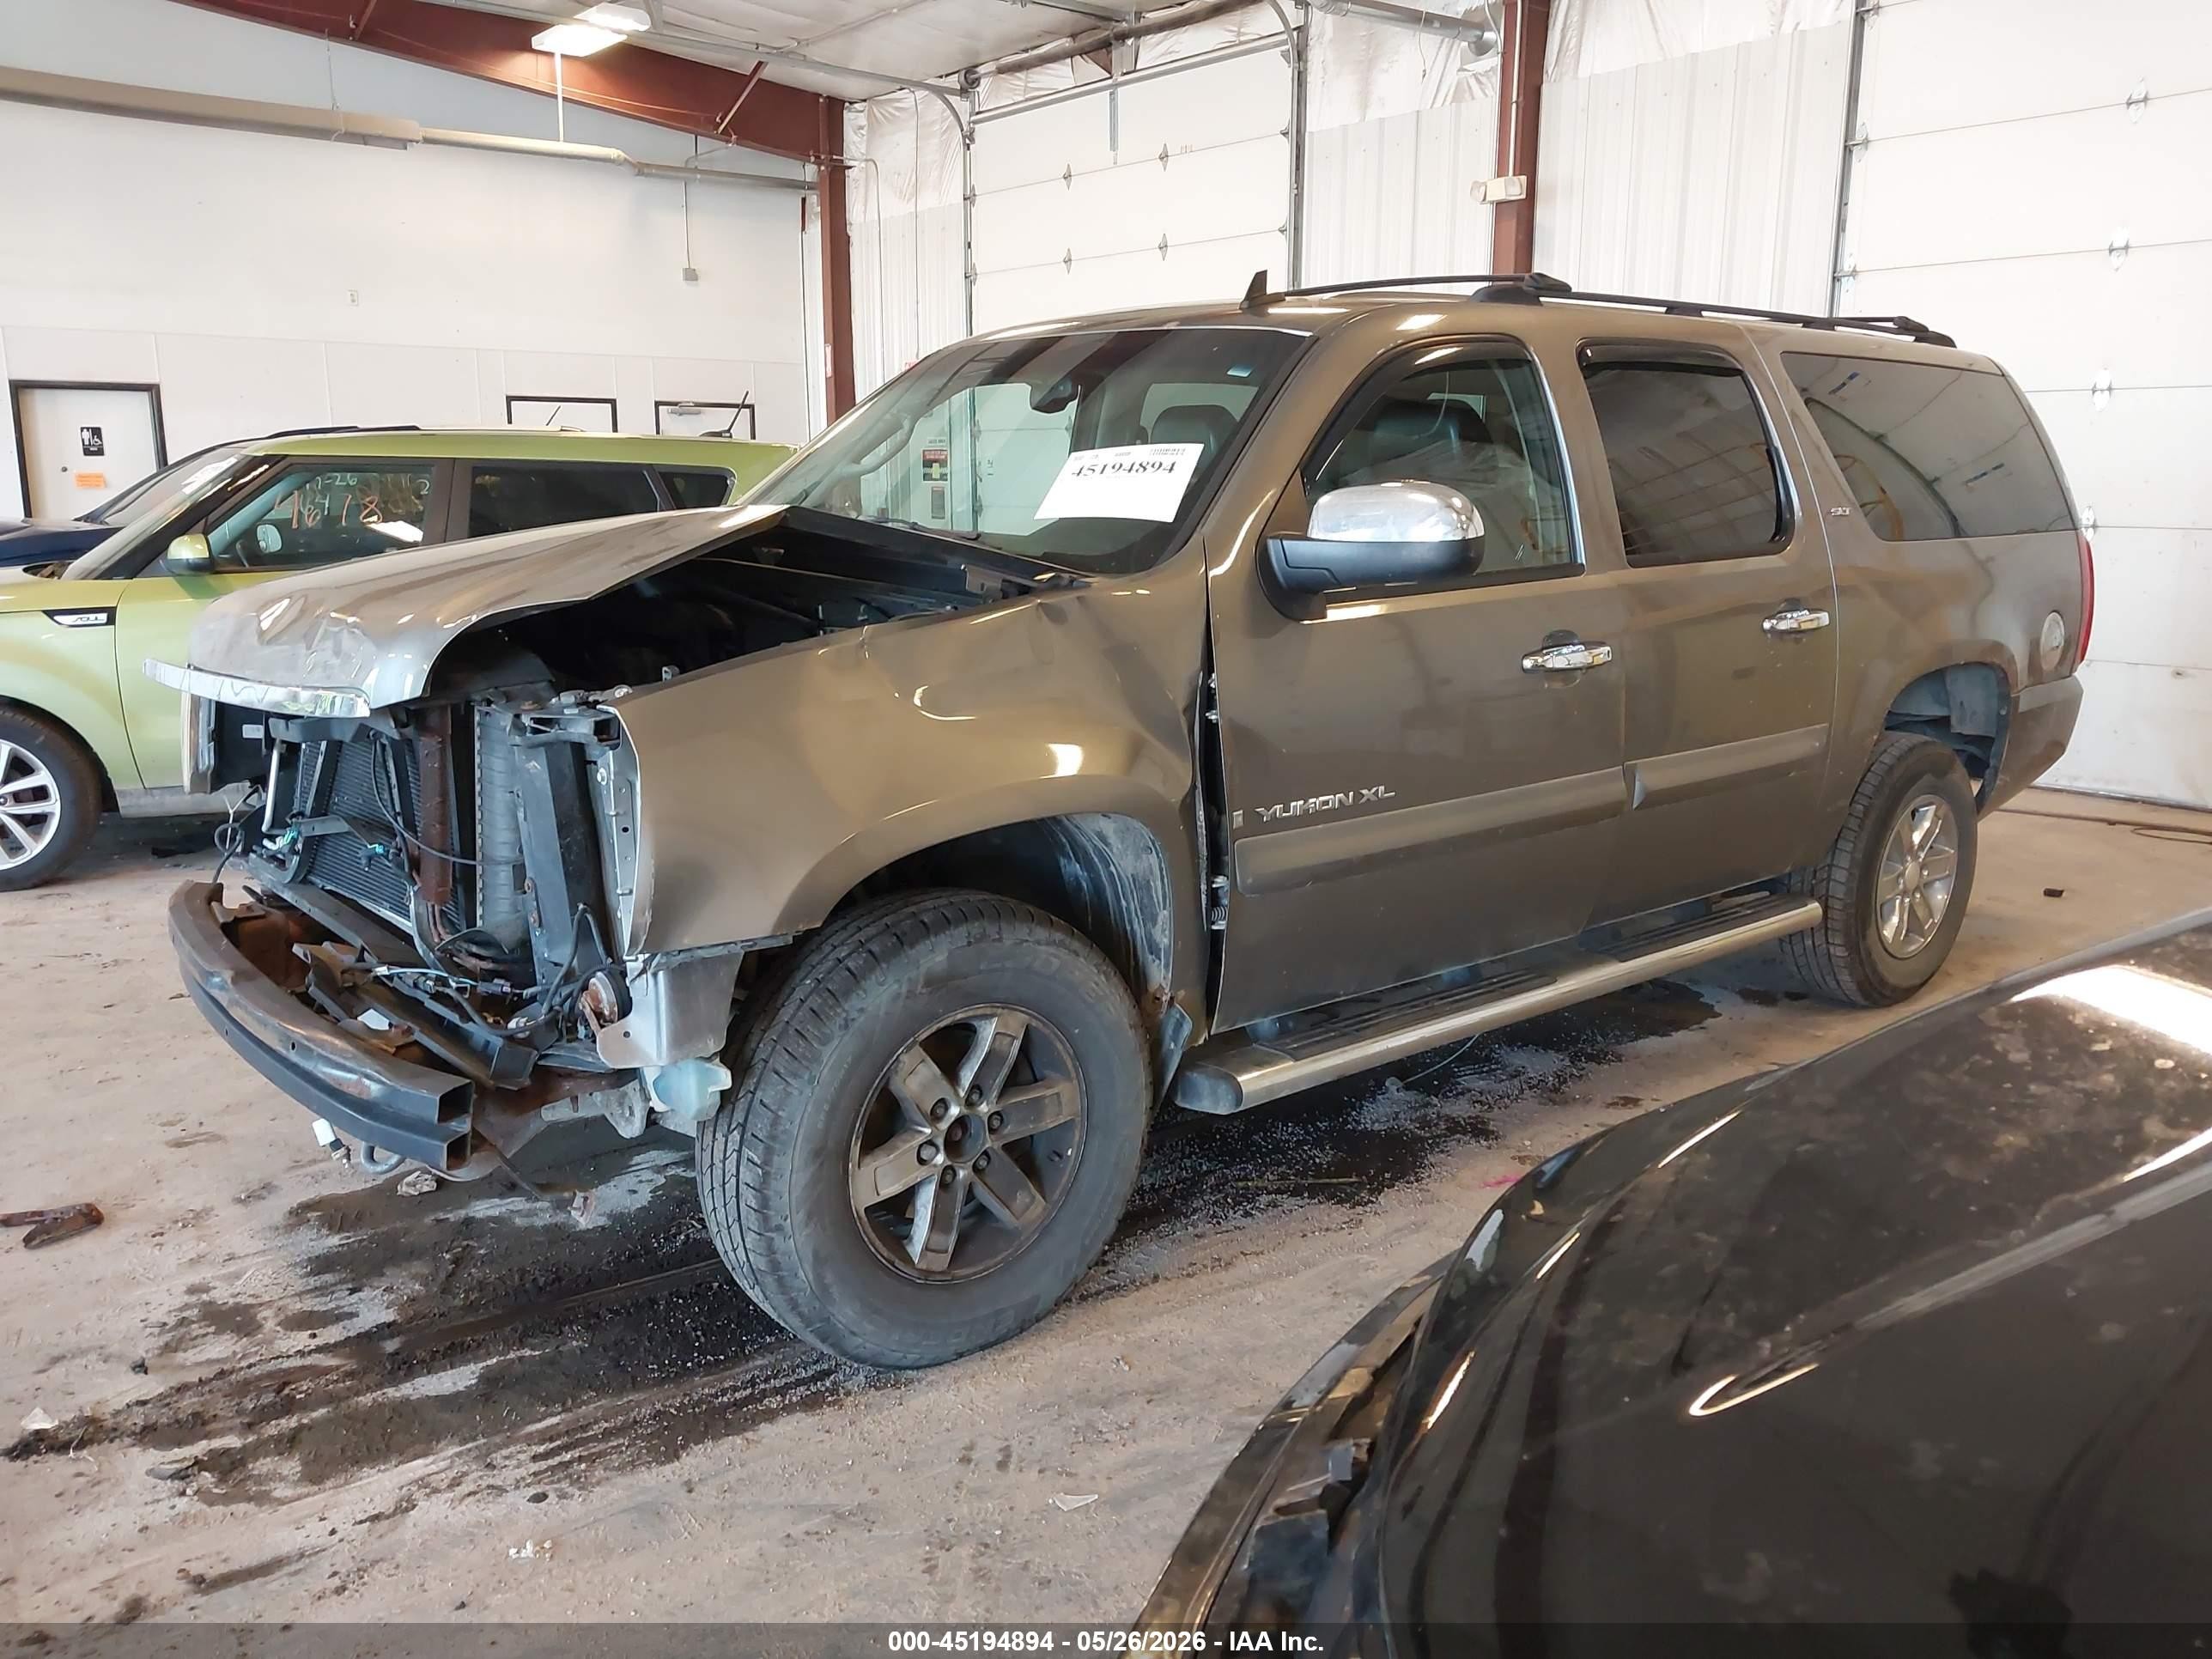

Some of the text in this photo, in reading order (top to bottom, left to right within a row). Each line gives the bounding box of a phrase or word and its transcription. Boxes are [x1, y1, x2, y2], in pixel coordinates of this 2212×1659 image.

[1071, 460, 1176, 477] 45194894
[1255, 785, 1395, 823] YUKON XL
